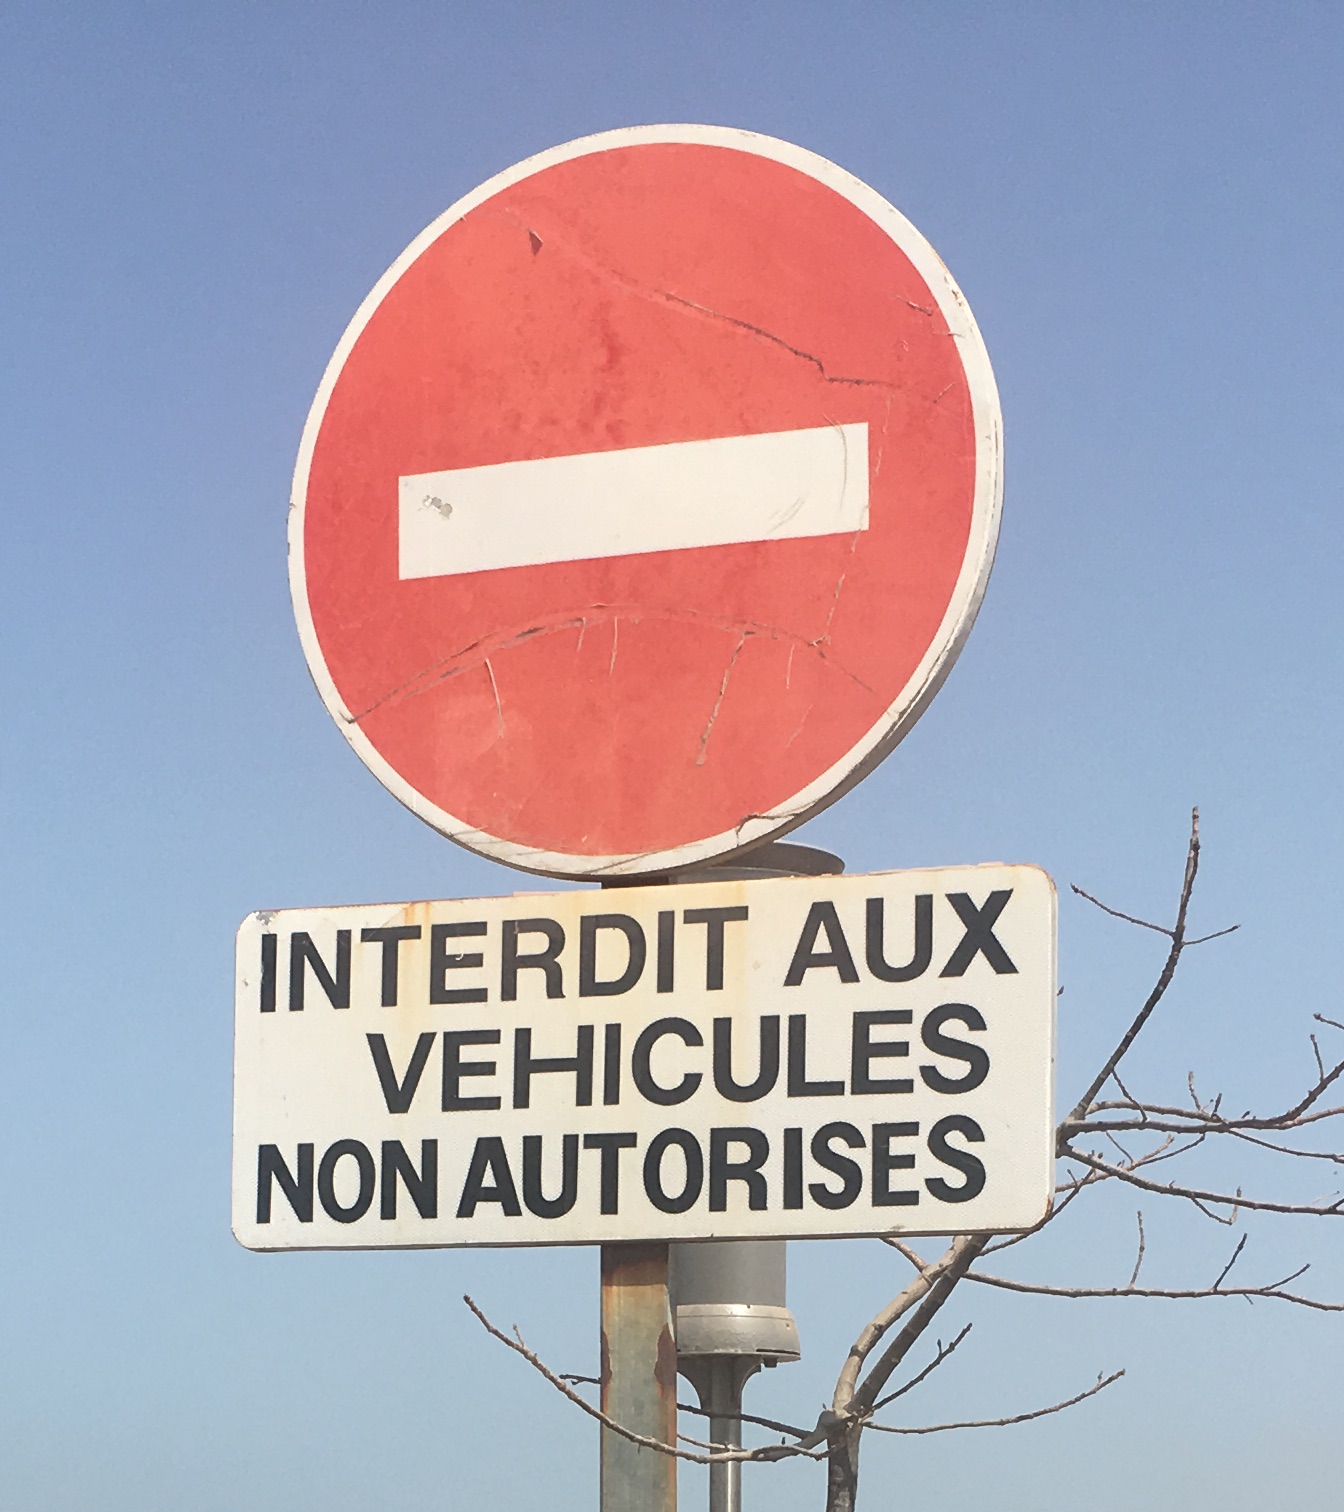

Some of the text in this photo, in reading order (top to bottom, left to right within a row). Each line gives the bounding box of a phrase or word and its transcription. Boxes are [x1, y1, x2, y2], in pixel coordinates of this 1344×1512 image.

[259, 888, 1019, 1013] INTERDIT AUX
[366, 1003, 991, 1114] VEHICULES
[256, 1114, 987, 1225] NON AUTORISES
